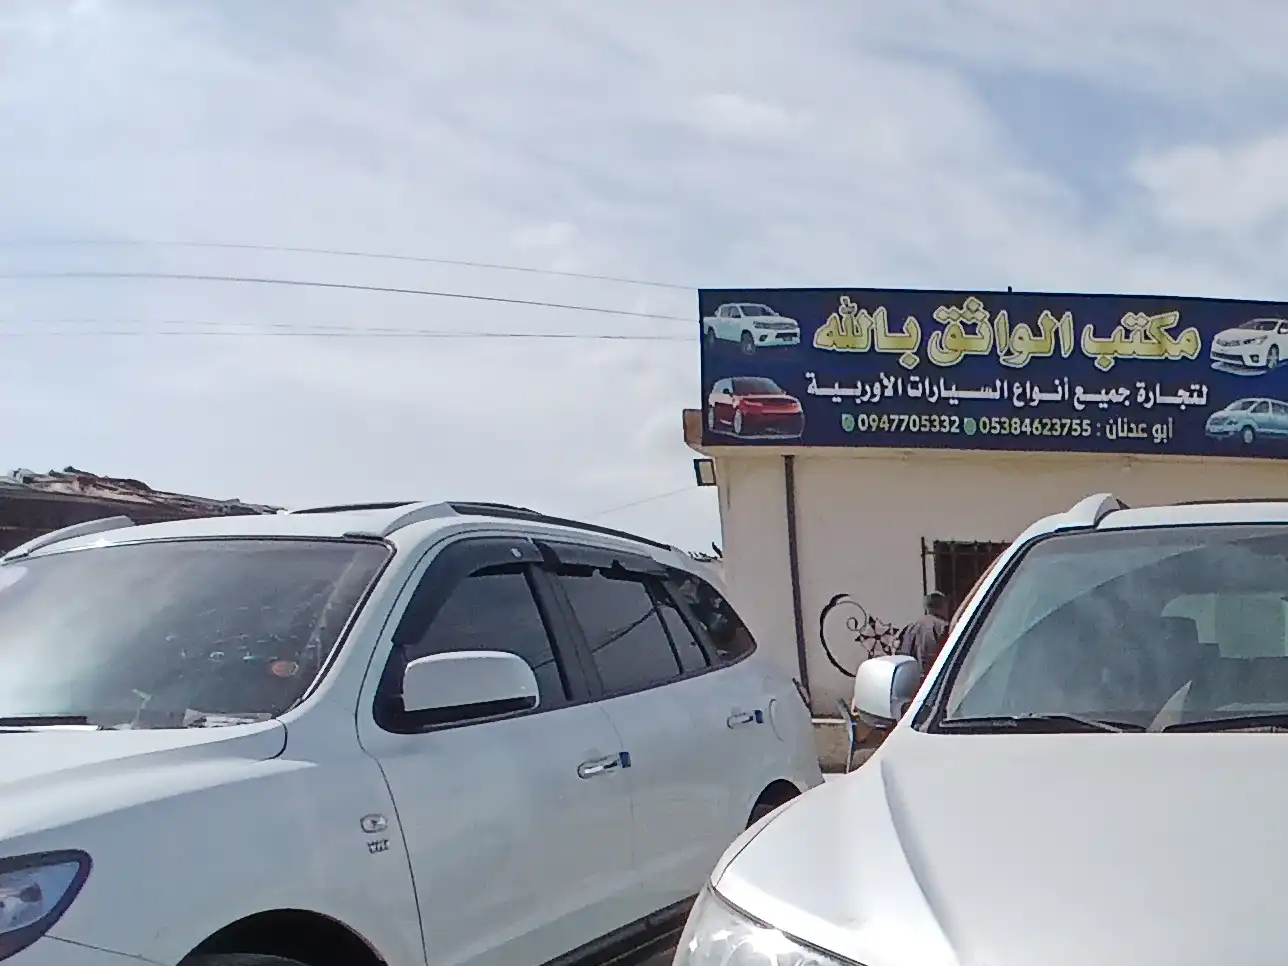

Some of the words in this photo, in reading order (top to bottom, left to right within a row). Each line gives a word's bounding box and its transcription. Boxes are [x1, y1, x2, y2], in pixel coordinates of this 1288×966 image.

[813, 295, 921, 369] بالله
[927, 296, 1075, 368] الواثق
[1081, 311, 1201, 371] مكتب
[805, 372, 902, 404] الأوربية
[907, 376, 1008, 405] السيارات
[1013, 377, 1069, 407] أنواع
[1074, 385, 1130, 410] جميع
[1136, 381, 1208, 410] لتجارة
[858, 414, 960, 433] 0947705332
[980, 417, 1092, 437] 05384623755
[1106, 418, 1148, 439] عدنان
